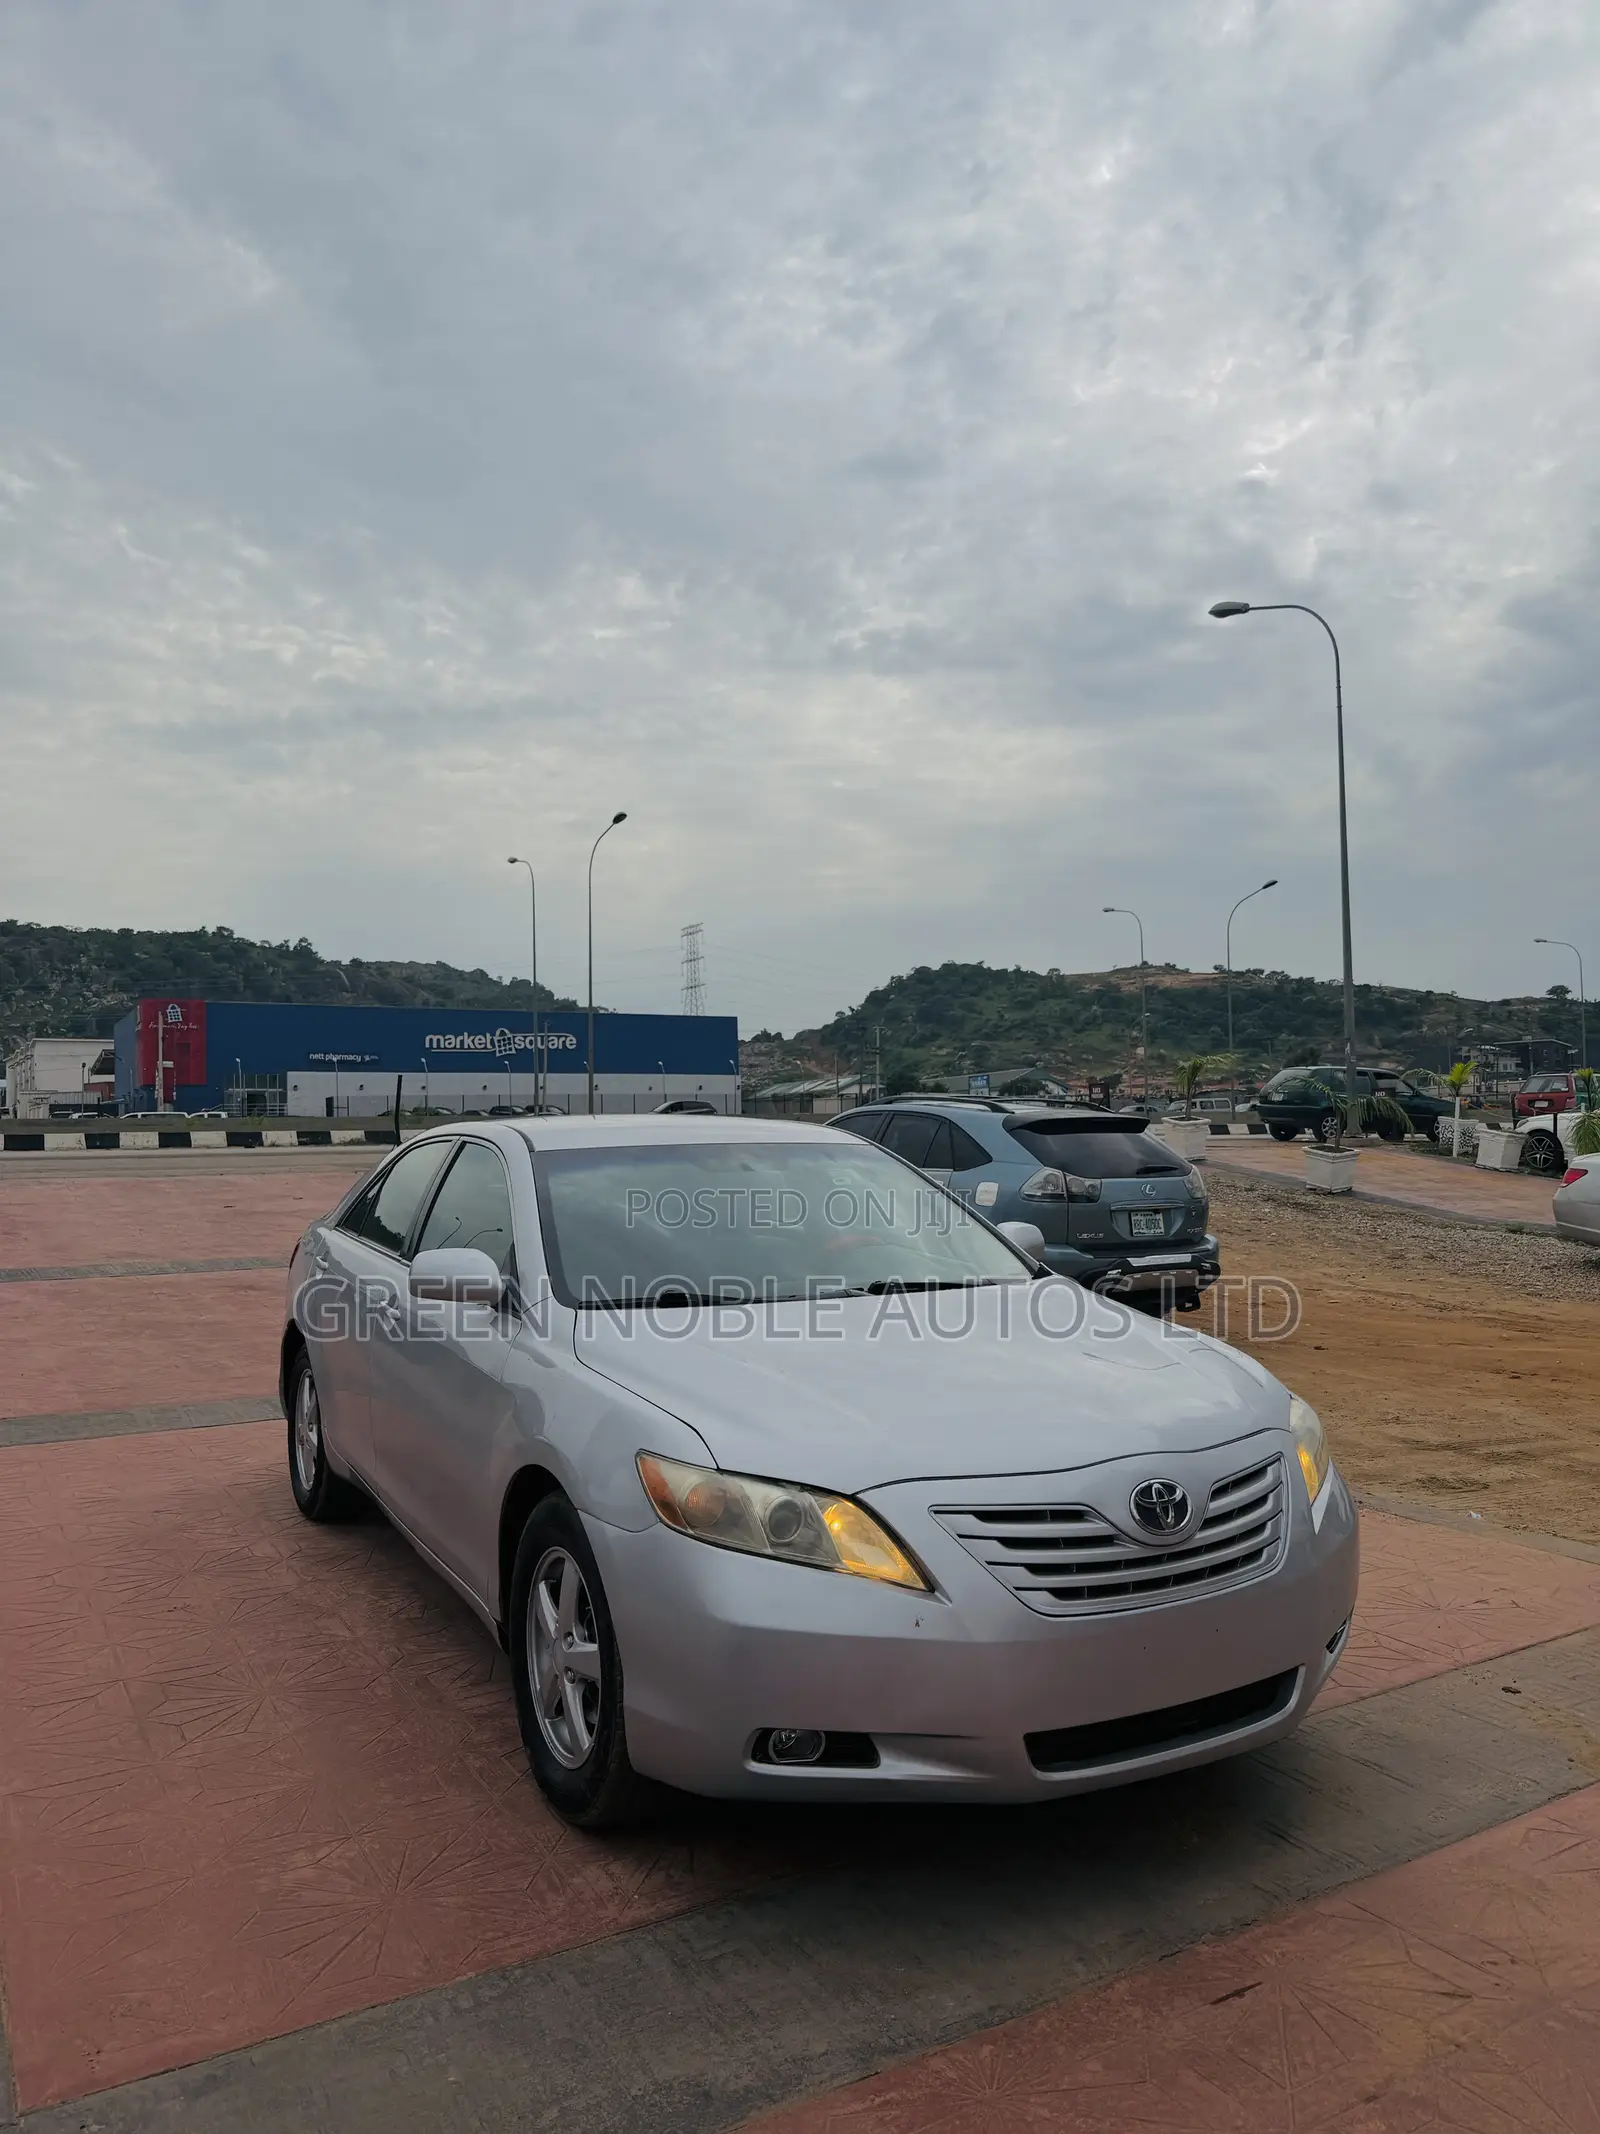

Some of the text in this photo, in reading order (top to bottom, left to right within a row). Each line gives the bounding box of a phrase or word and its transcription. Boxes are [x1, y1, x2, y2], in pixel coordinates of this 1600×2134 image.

[425, 1032, 577, 1053] market square
[325, 1053, 361, 1062] pharmacy
